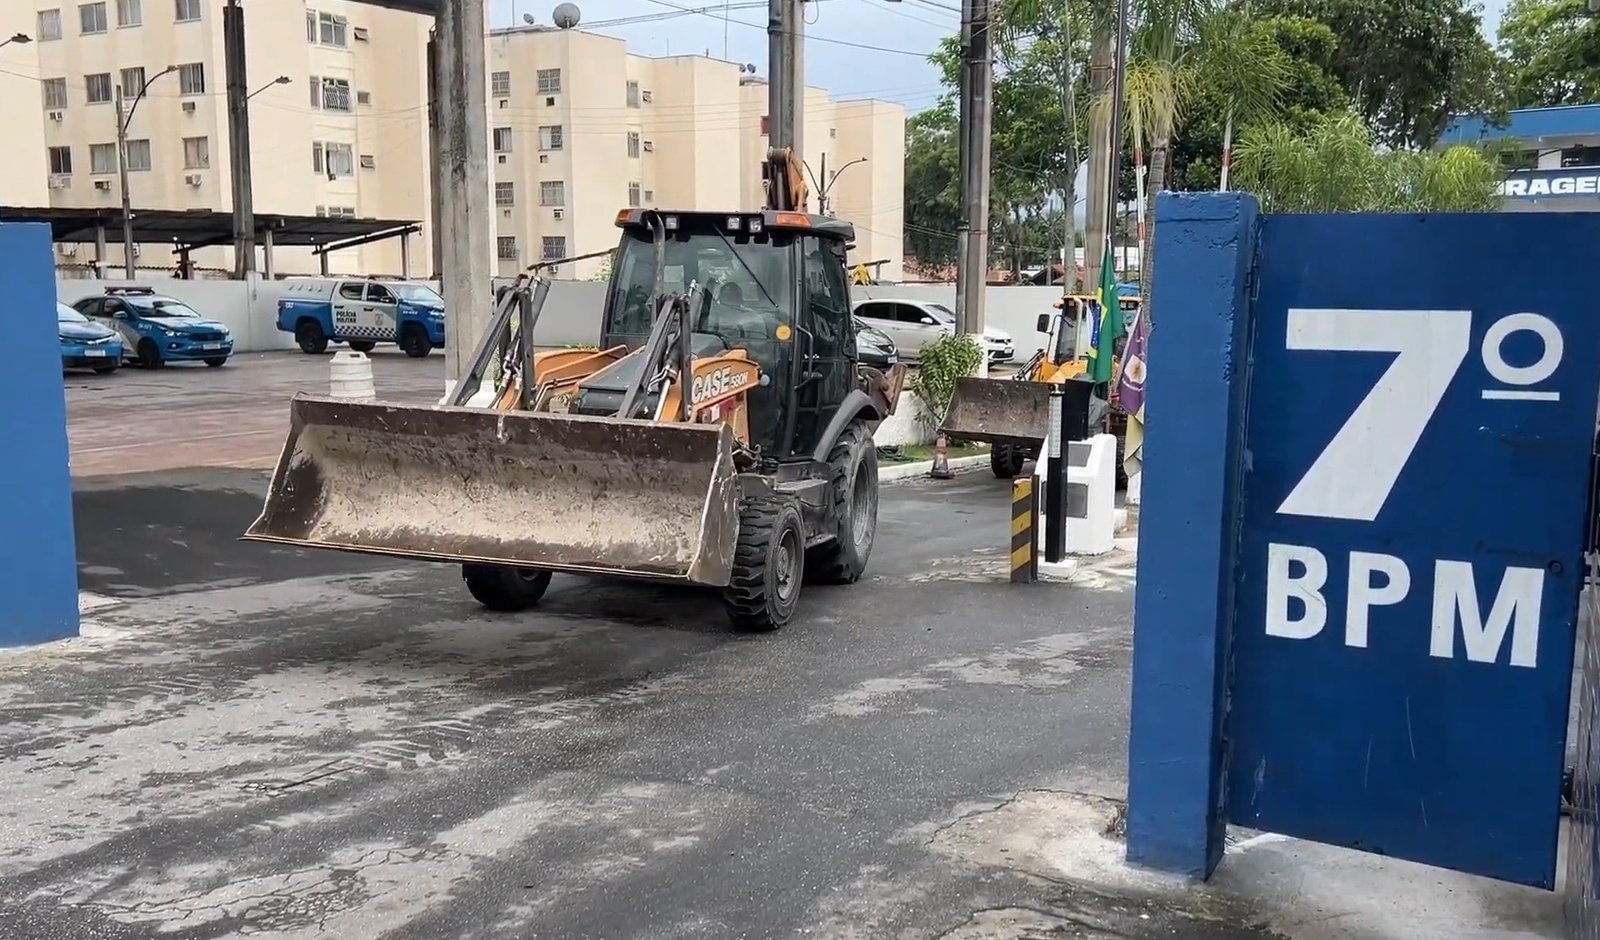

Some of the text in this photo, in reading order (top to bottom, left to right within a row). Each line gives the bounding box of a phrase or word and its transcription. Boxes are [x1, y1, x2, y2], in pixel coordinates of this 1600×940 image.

[692, 365, 731, 404] CASE
[1276, 308, 1563, 521] 7º
[1265, 542, 1545, 668] BPM
